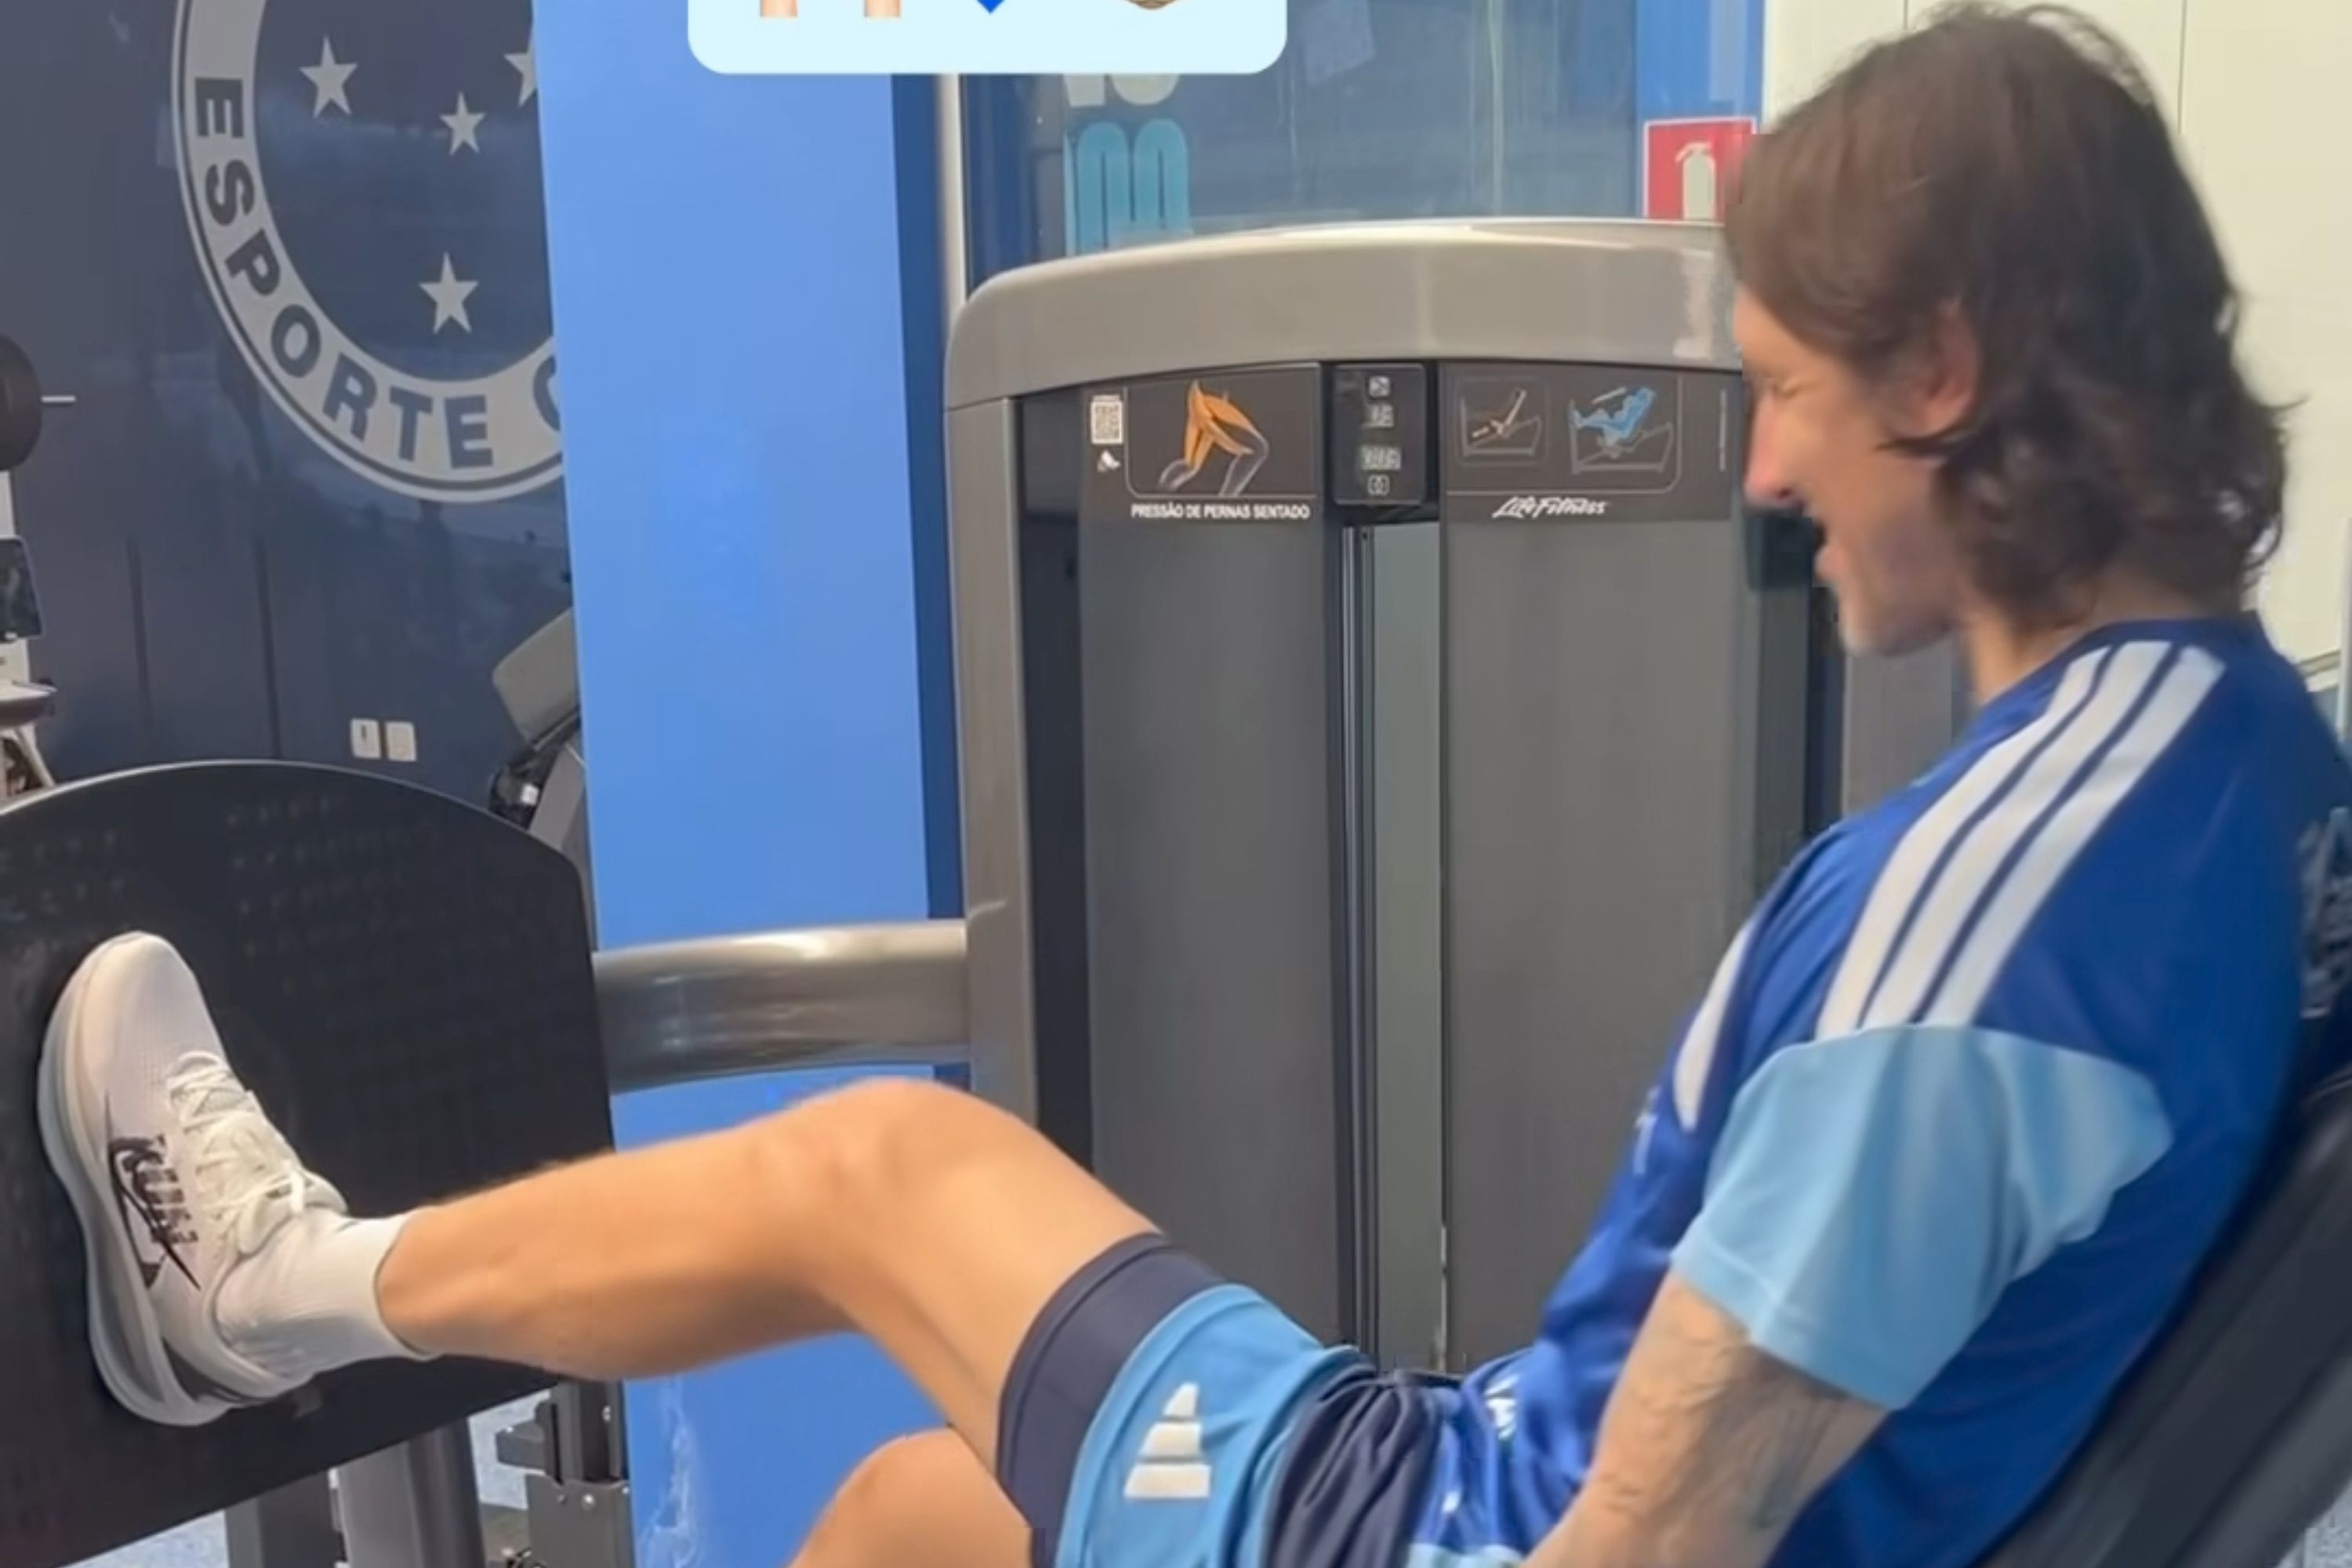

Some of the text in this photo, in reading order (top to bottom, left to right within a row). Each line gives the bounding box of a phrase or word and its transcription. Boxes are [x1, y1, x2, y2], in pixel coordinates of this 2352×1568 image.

[194, 77, 494, 470] ESPORTE
[1131, 502, 1311, 520] PRESSÃO DE PERNAS SENTADO
